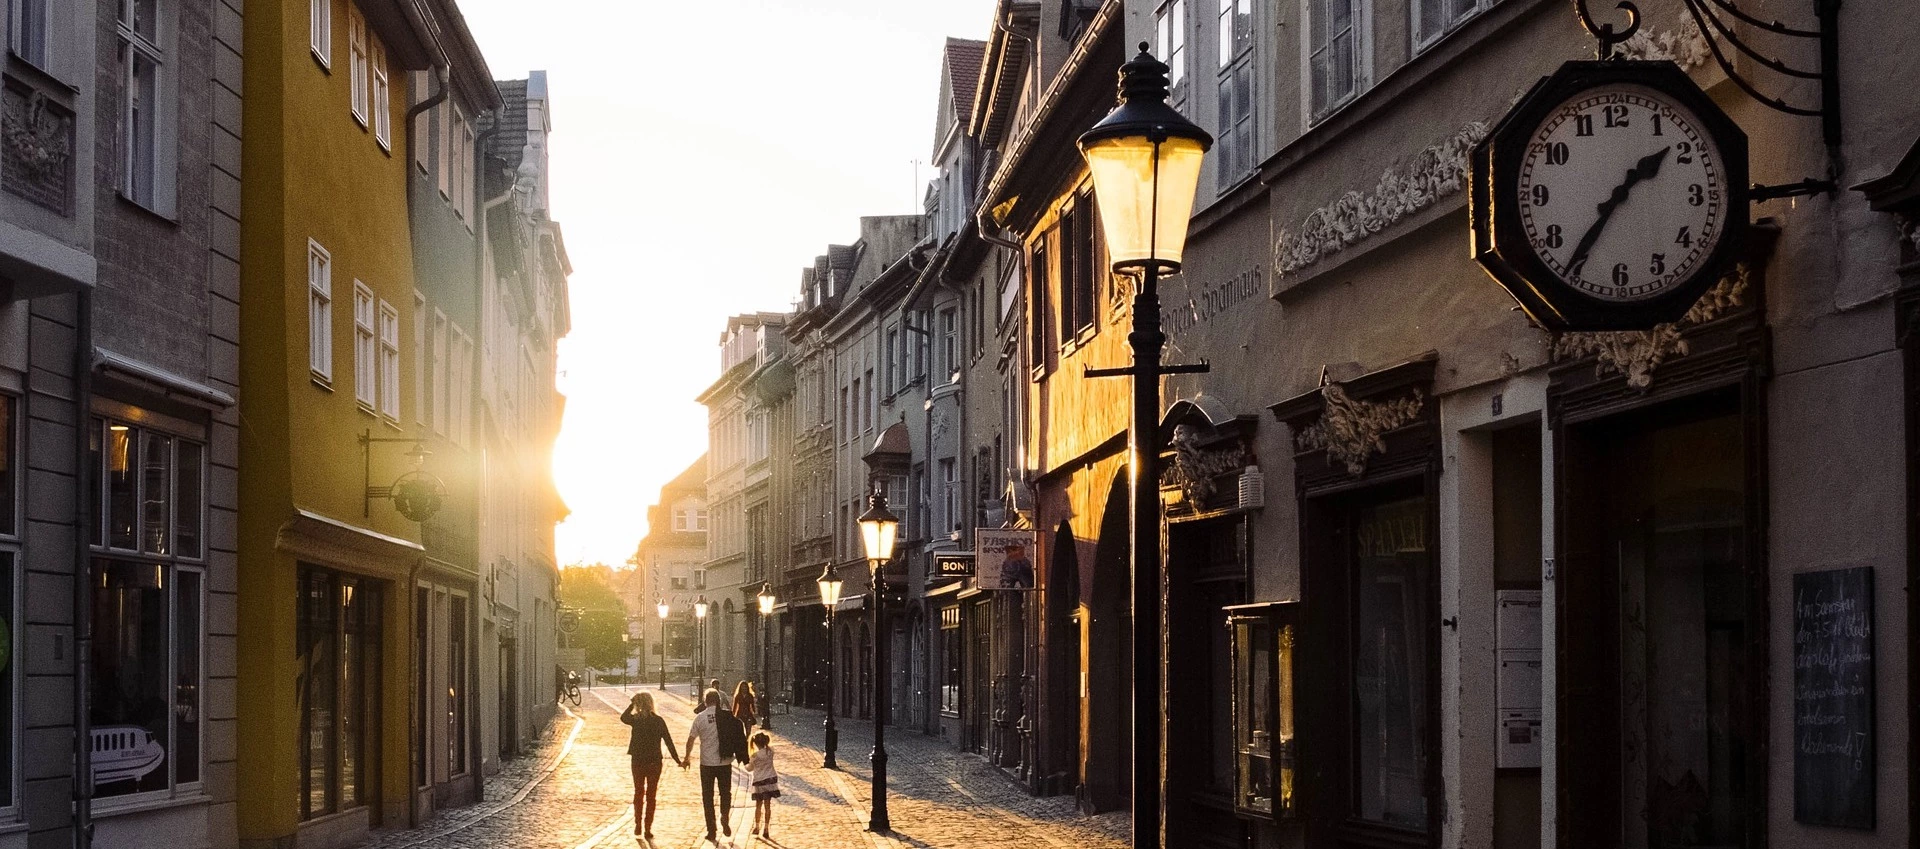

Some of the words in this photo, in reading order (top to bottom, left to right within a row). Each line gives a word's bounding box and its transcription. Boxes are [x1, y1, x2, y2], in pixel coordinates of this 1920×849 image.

[1609, 93, 1625, 104] 24
[1563, 106, 1578, 117] 23
[1602, 105, 1629, 128] 12
[1661, 106, 1672, 117] 13
[1574, 114, 1594, 137] 11
[1650, 113, 1663, 136] 1
[1530, 142, 1544, 153] 22
[1544, 142, 1569, 165] 10
[1676, 141, 1692, 165] 2
[1532, 184, 1549, 206] 9
[1688, 183, 1704, 206] 3
[1708, 190, 1719, 200] 15
[1530, 238, 1545, 249] 20
[1546, 224, 1563, 249] 8
[1674, 225, 1694, 248] 4
[1697, 238, 1708, 248] 16
[1612, 263, 1629, 286] 6
[1650, 252, 1665, 275] 5
[1569, 275, 1580, 286] 19
[1664, 274, 1675, 285] 17
[1201, 264, 1262, 327] Spannaus
[1615, 287, 1627, 298] 18
[1795, 588, 1814, 619] Am
